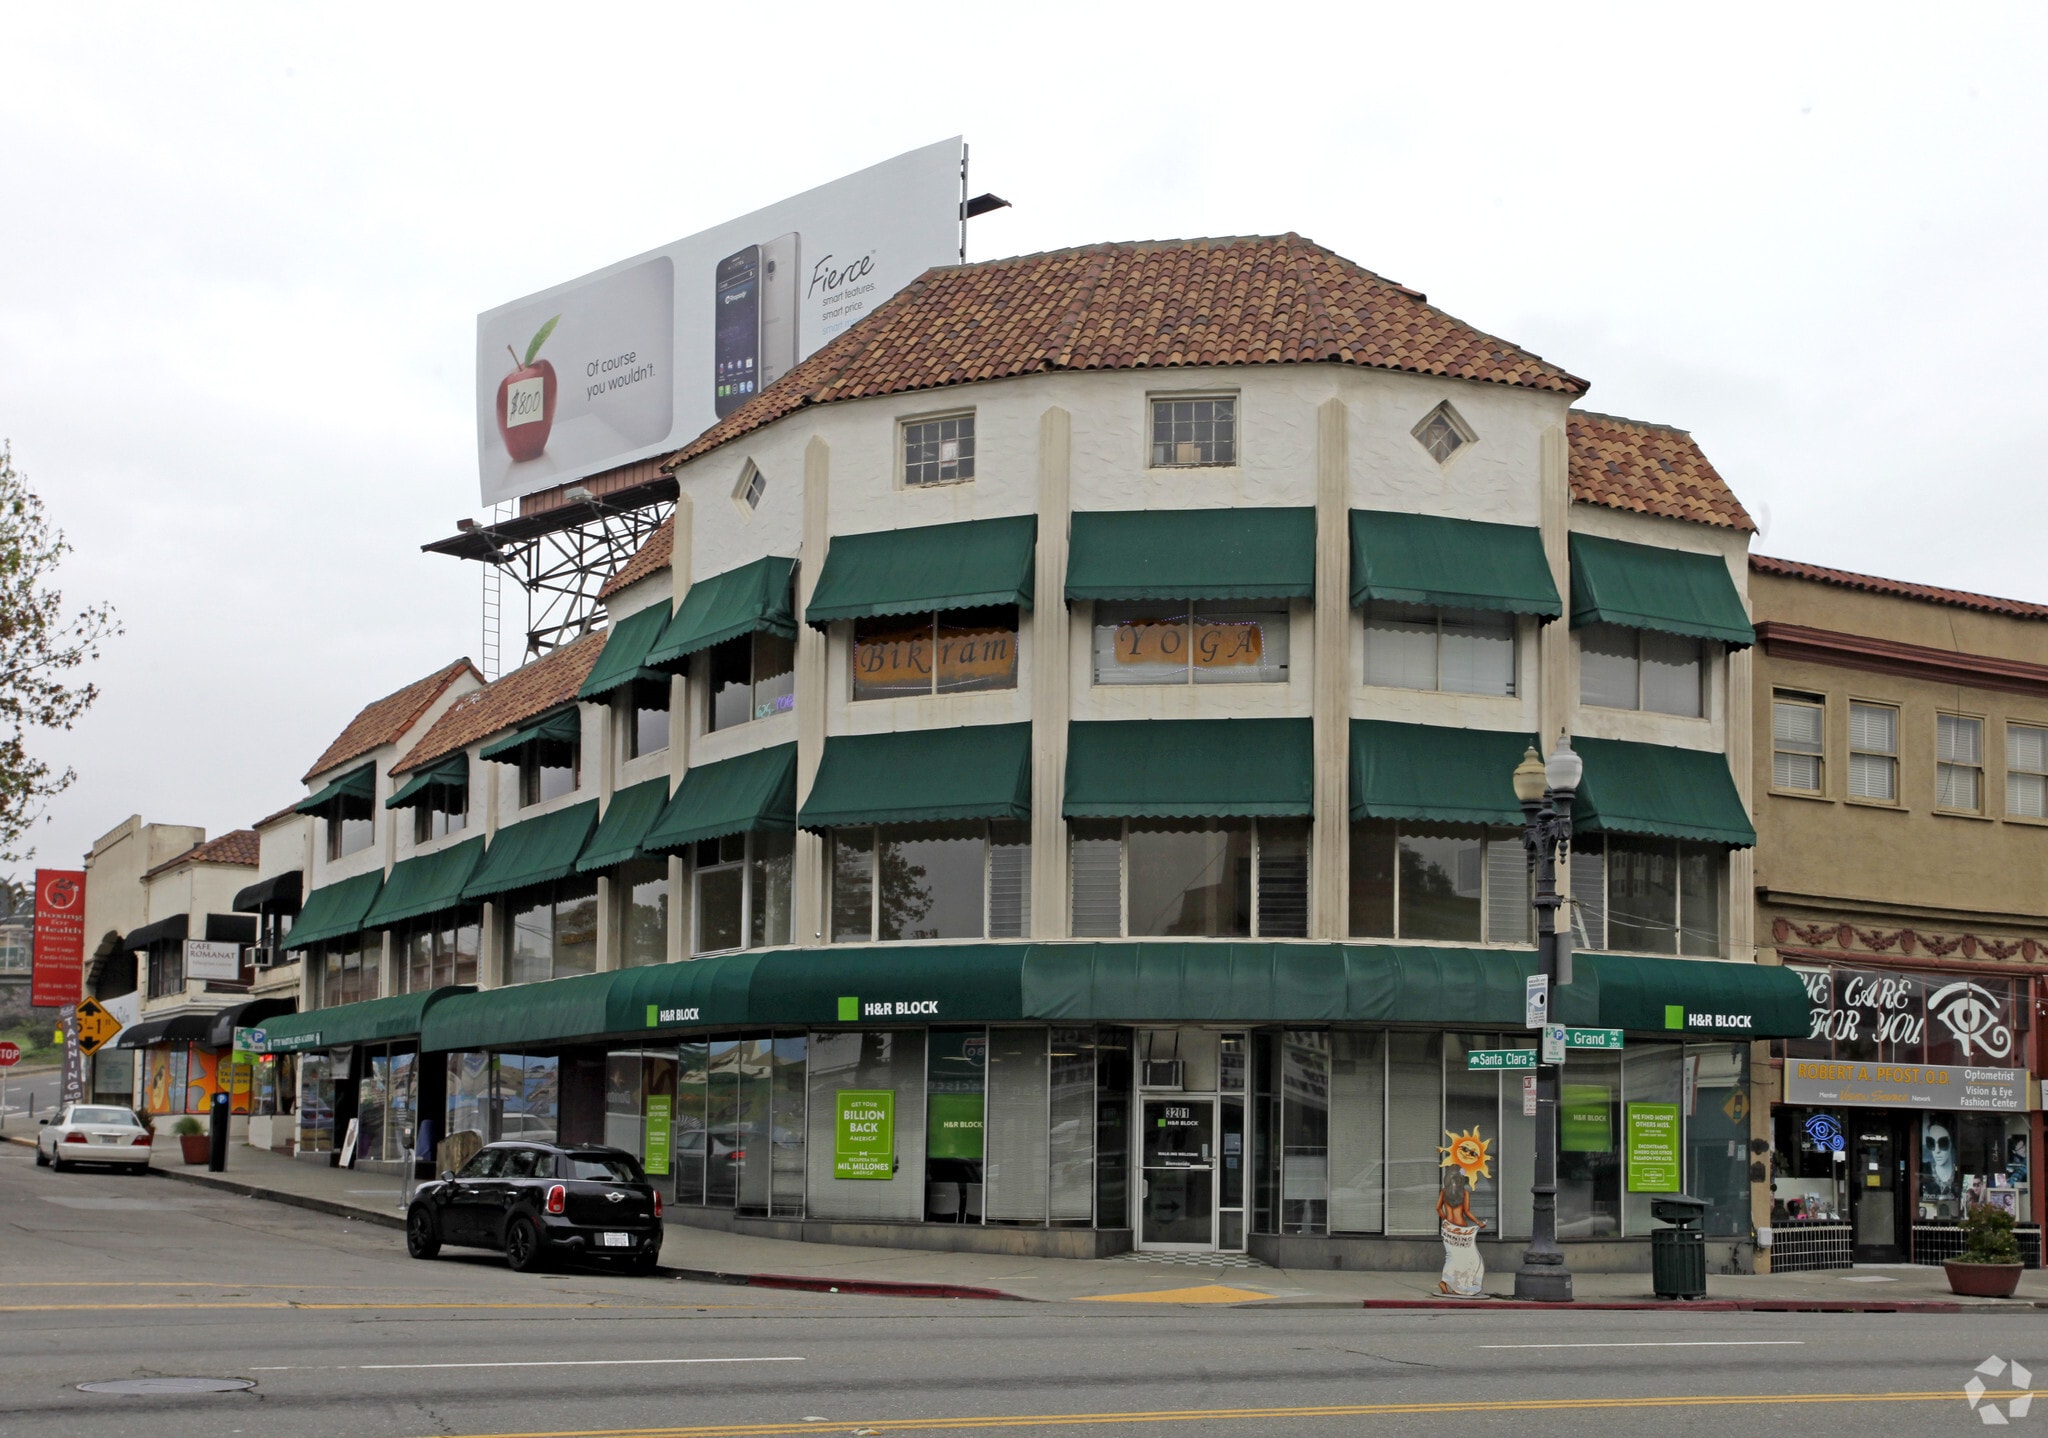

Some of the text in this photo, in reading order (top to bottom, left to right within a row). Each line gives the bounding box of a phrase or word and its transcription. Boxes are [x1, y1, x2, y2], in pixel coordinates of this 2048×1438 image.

[808, 254, 875, 300] Fierce
[822, 282, 876, 306] smart features.
[822, 305, 843, 321] smart
[586, 351, 636, 377] Of course
[586, 363, 656, 401] you wouldn't.
[510, 389, 541, 421] $800
[1119, 626, 1253, 663] YOGA
[860, 638, 1008, 674] Bikram
[38, 911, 83, 921] Boxing
[38, 925, 82, 935] Health
[190, 951, 236, 960] ROMANAT
[1844, 976, 1912, 1009] CARE
[660, 1007, 699, 1022] H&R BLOCK
[864, 1000, 939, 1016] H&R BLOCK
[1688, 1013, 1752, 1028] H&R BLOCK
[1806, 1007, 1925, 1044] FOR YOU
[1574, 1032, 1605, 1045] Grand
[0, 1048, 20, 1060] TOP
[65, 1016, 79, 1090] TANNING
[1480, 1053, 1527, 1065] Santa Clara
[1798, 1063, 1855, 1081] ROBERT
[1857, 1066, 1873, 1082] A.
[1925, 1069, 1953, 1086] O.D.
[1964, 1069, 2015, 1082] Optometrist
[1819, 1091, 1838, 1099] Member
[1965, 1085, 2013, 1098] Vision & Eye
[1960, 1097, 2018, 1108] Fashion Center
[843, 1110, 885, 1120] BILLION
[1166, 1107, 1190, 1119] 3201
[850, 1122, 878, 1132] BACK
[852, 1163, 889, 1171] MILLONES
